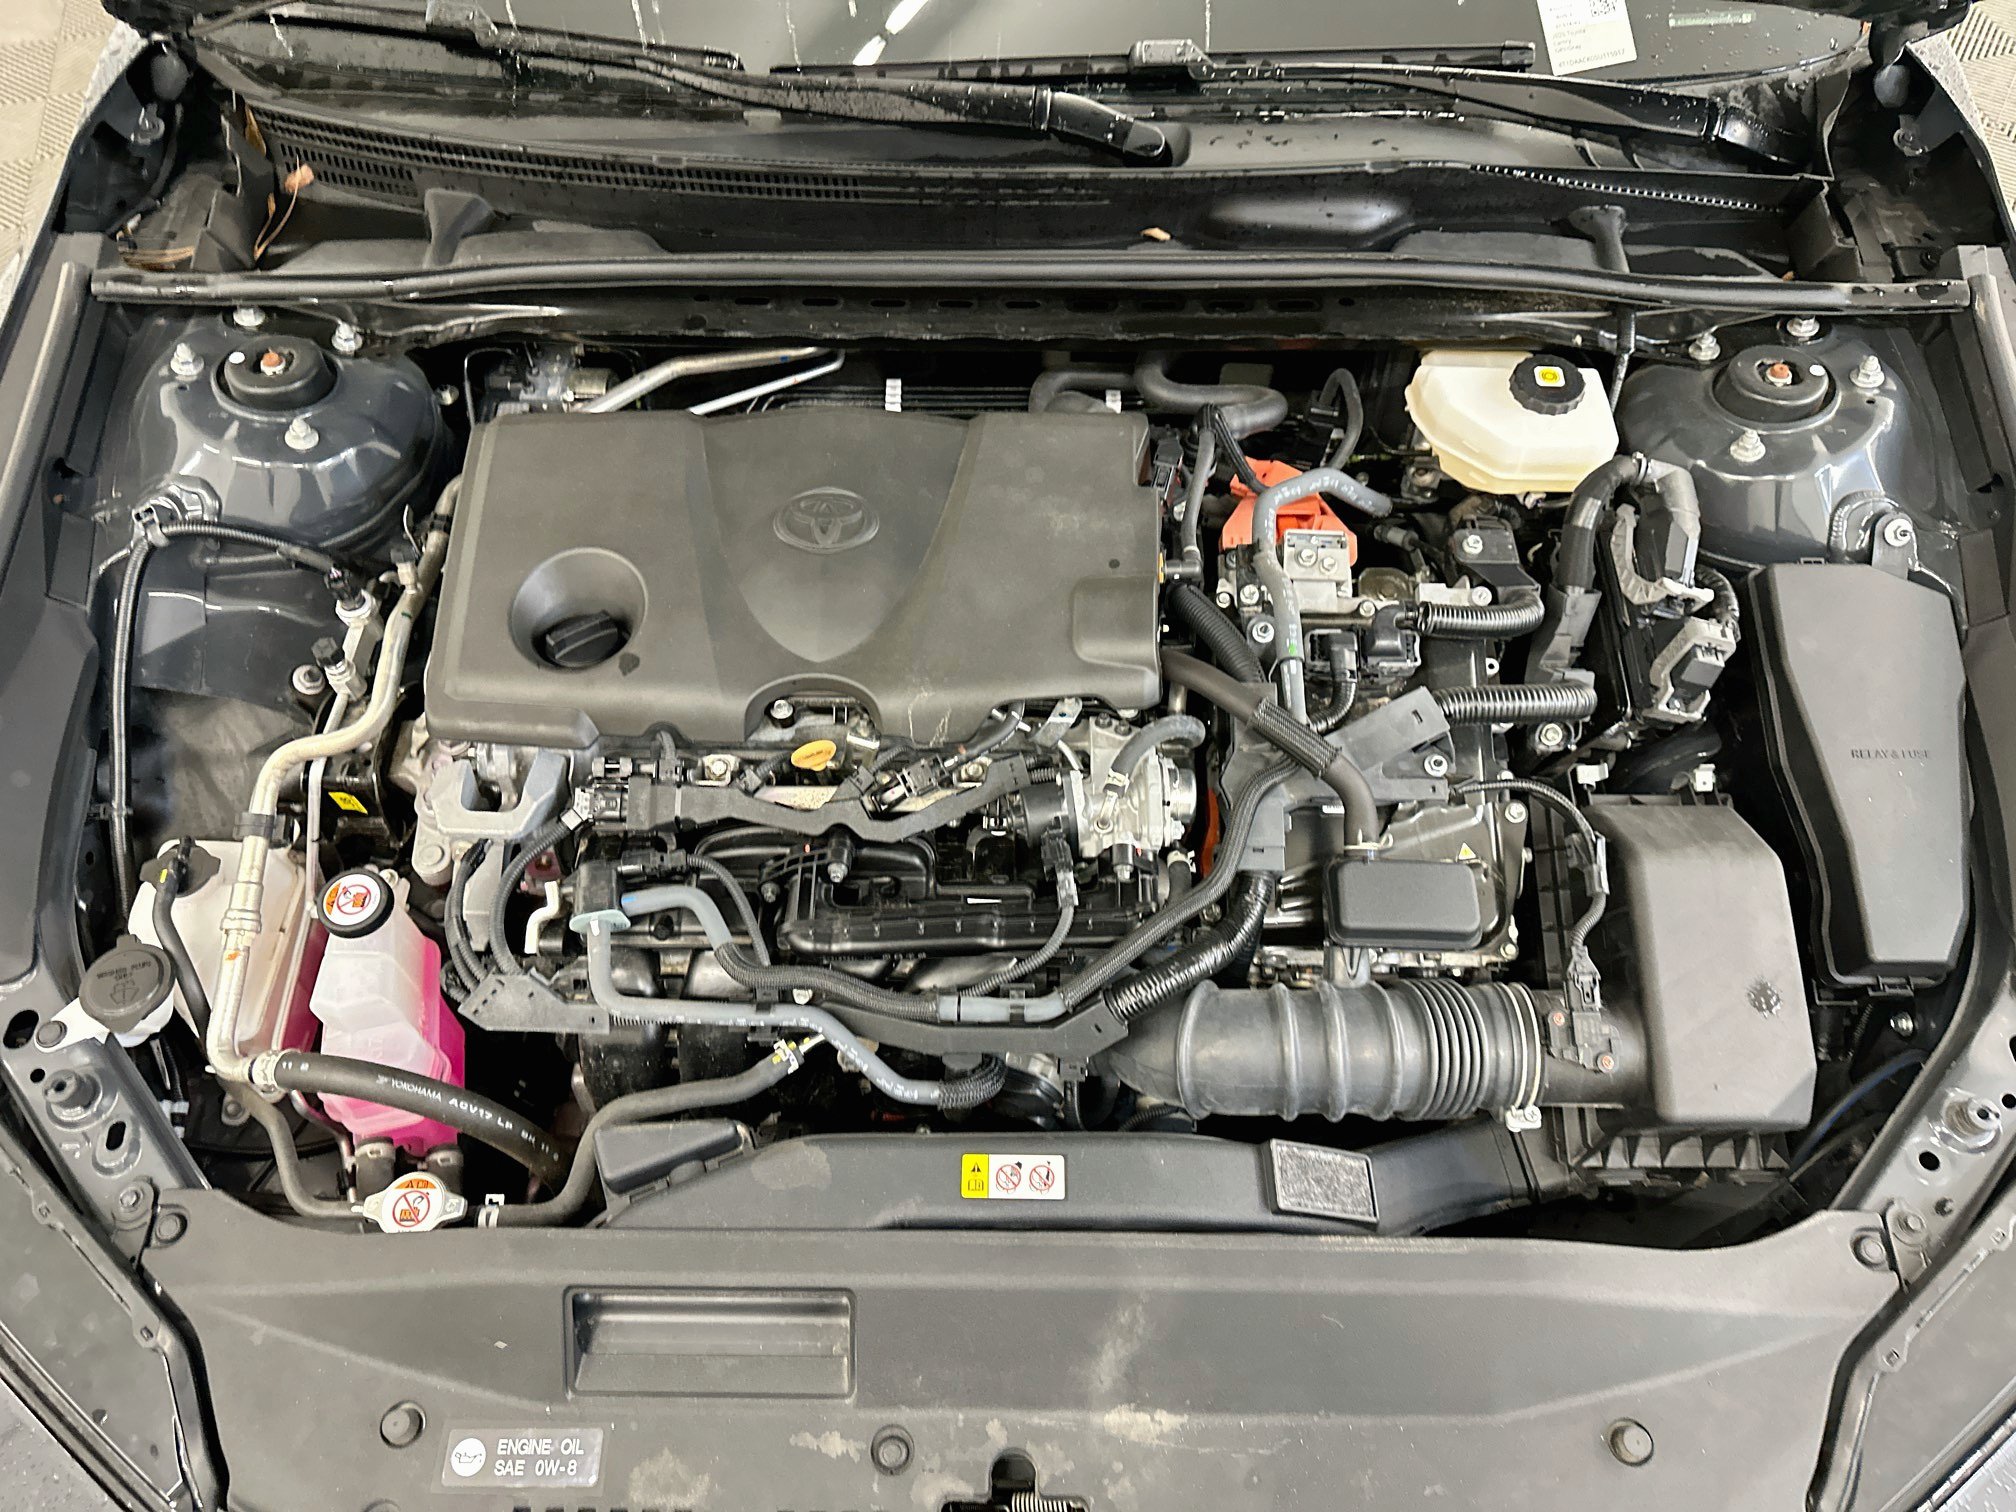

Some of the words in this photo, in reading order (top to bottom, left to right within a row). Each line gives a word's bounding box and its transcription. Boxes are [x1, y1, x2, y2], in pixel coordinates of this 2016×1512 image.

[1850, 749, 1888, 759] RELAY
[391, 1078, 443, 1103] YOKOHAMA
[497, 1438, 552, 1455] ENGINE
[560, 1438, 585, 1455] OIL
[494, 1459, 526, 1477] SAE
[535, 1459, 577, 1477] 0W-8
